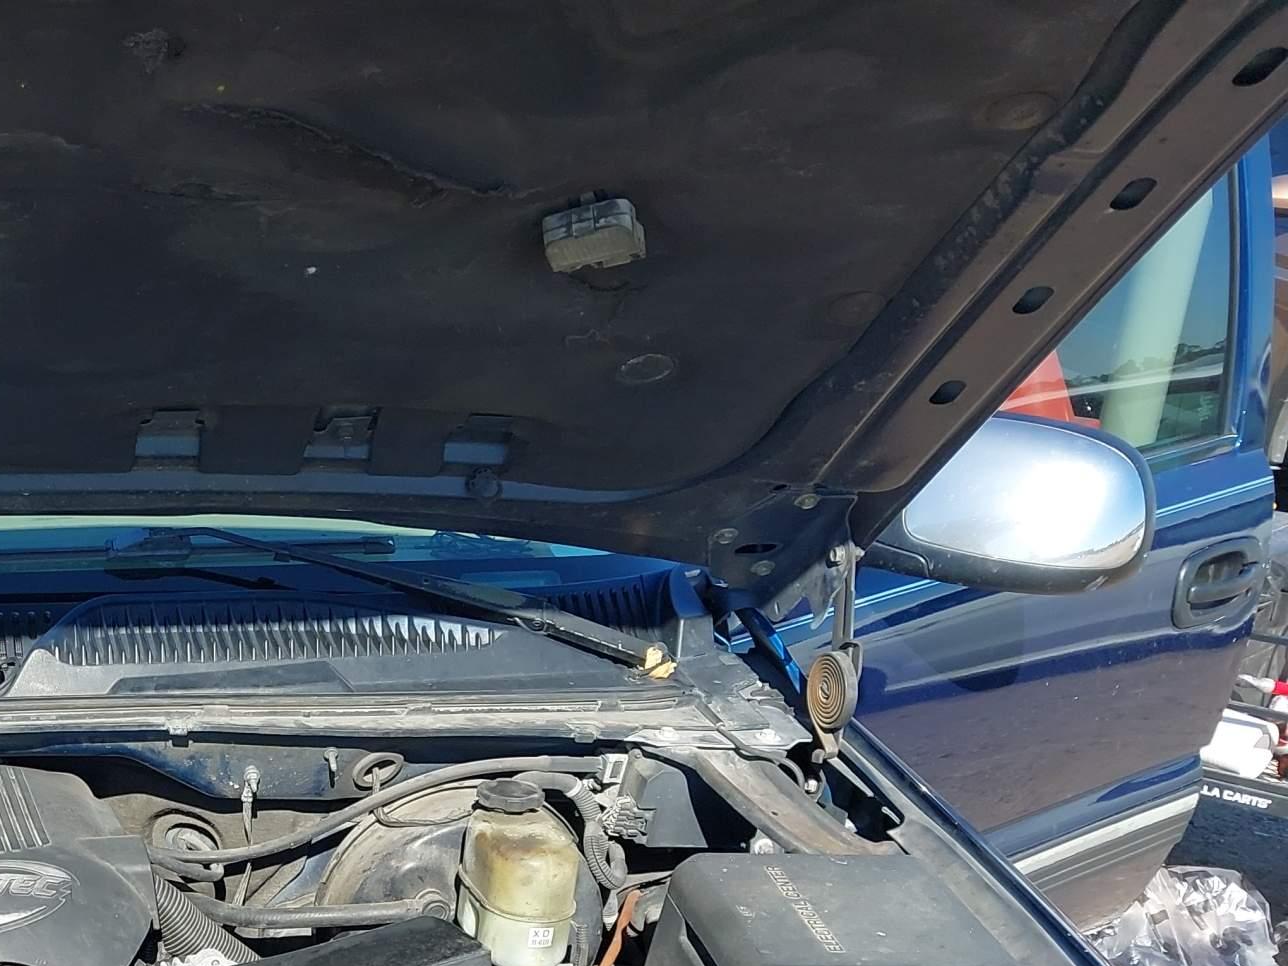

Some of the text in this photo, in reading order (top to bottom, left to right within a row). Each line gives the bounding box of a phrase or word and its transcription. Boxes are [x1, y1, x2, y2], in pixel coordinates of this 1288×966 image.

[1200, 784, 1269, 809] LA CARTS
[764, 865, 846, 953] ELECTRICAL CENTER
